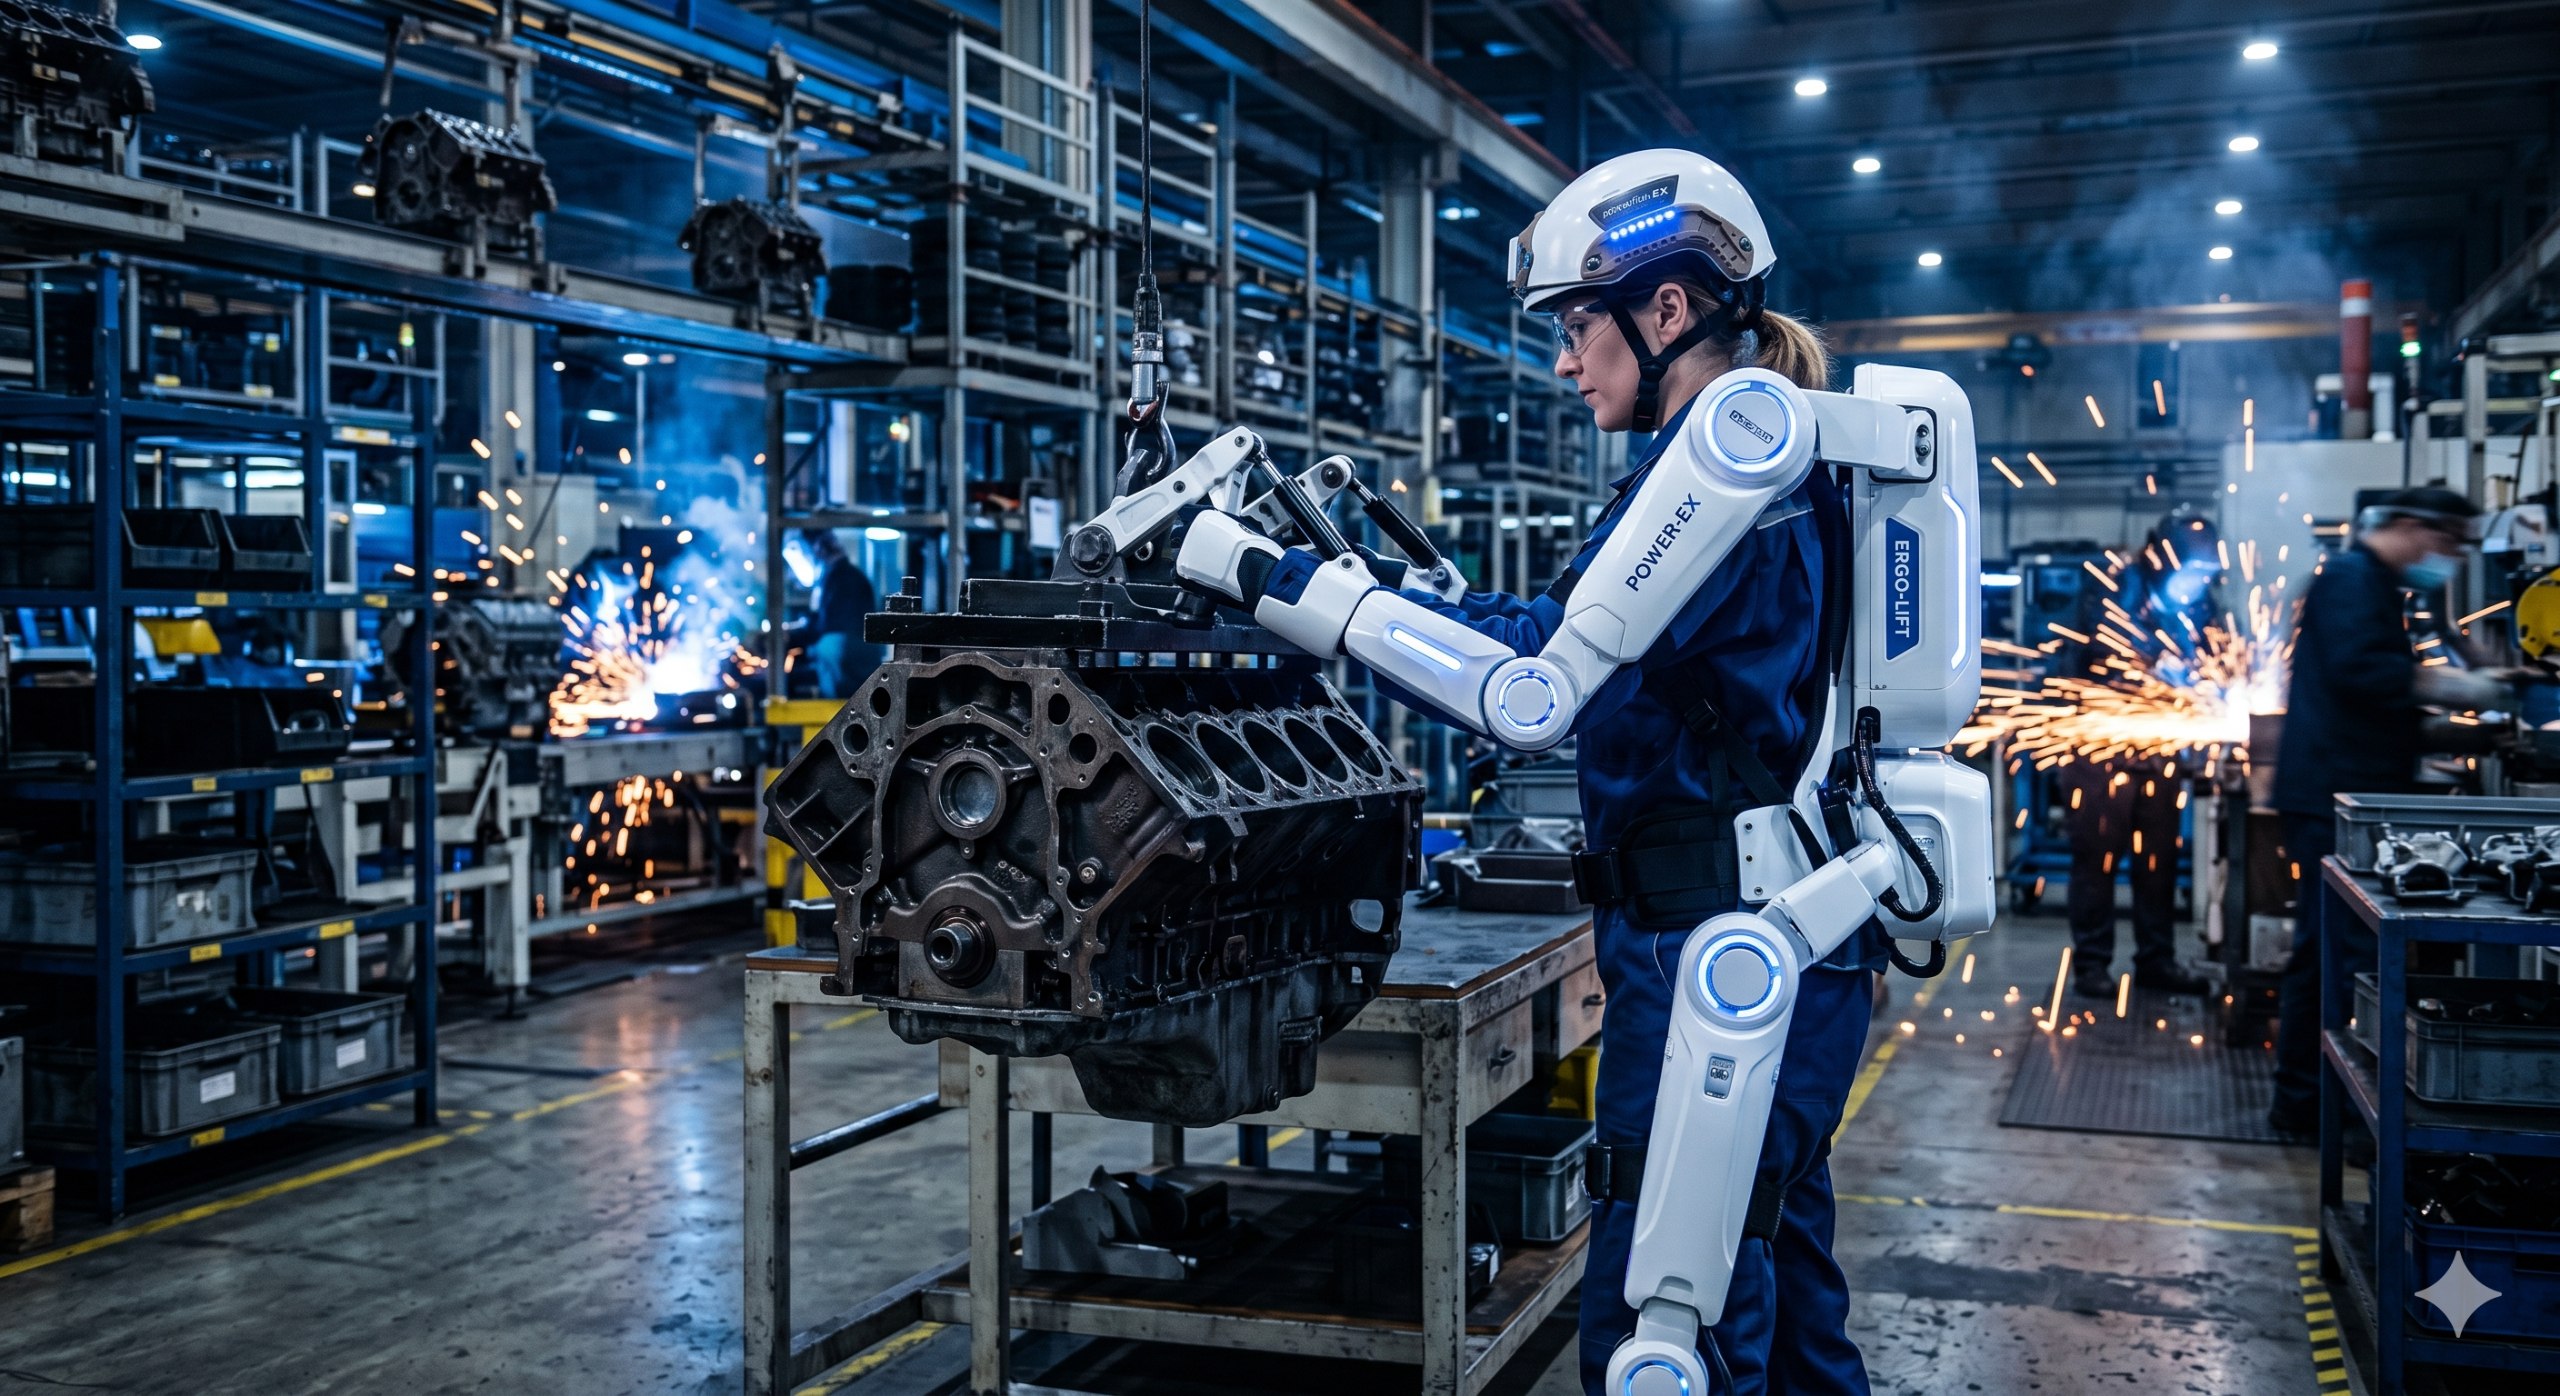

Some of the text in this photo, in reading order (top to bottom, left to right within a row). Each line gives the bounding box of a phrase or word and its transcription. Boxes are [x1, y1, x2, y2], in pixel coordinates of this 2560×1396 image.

[1652, 186, 1669, 199] EX
[1625, 492, 1701, 592] POWER-EX
[1894, 540, 1910, 638] ERGO-LIFT
